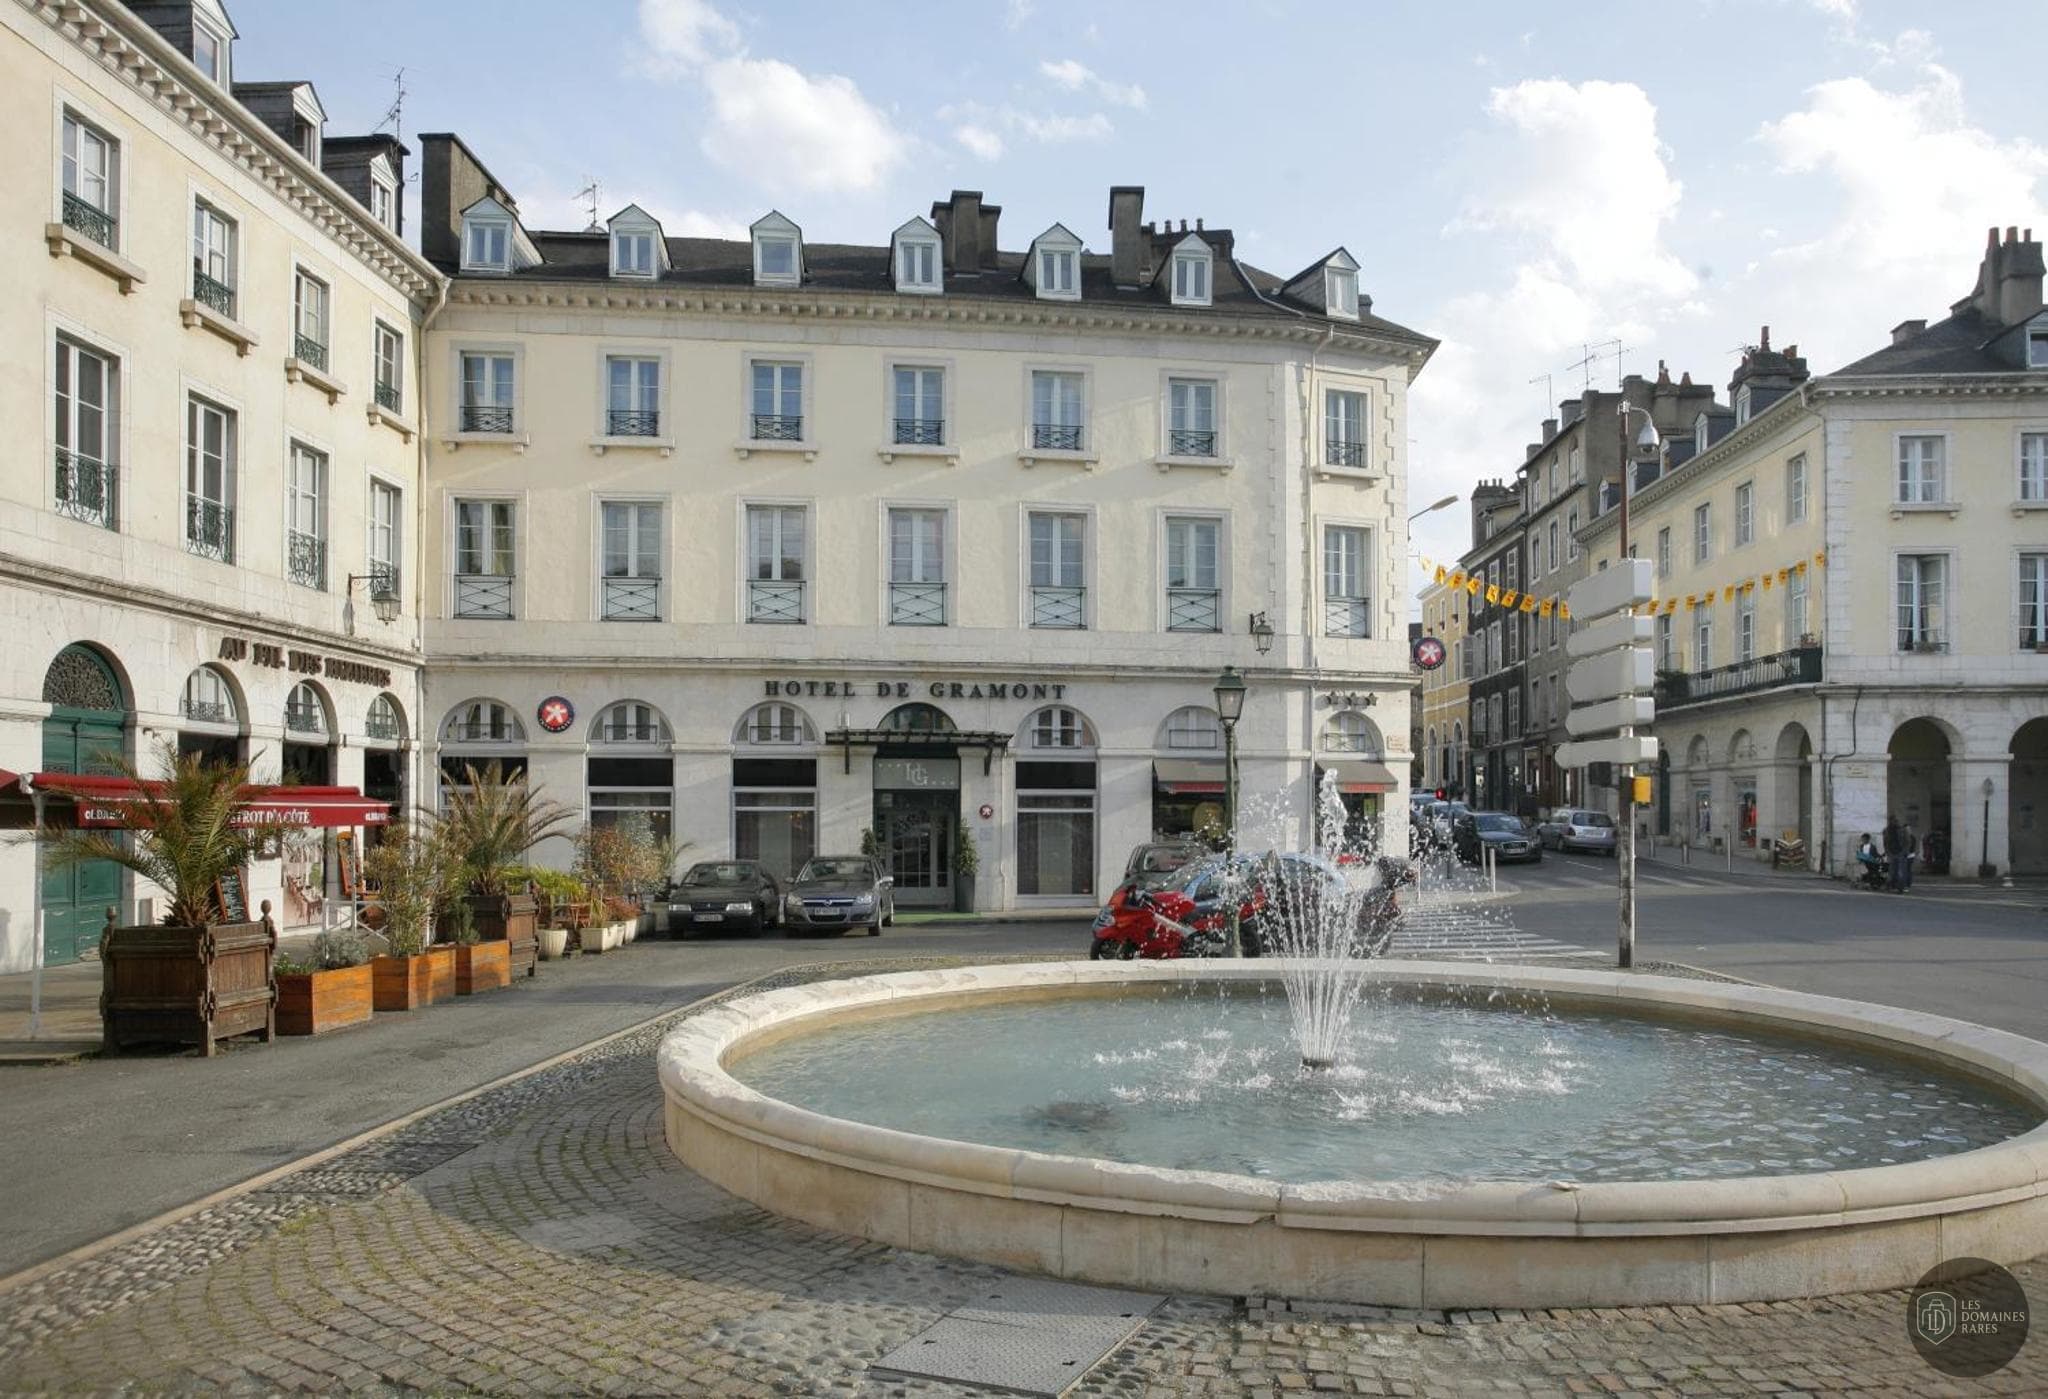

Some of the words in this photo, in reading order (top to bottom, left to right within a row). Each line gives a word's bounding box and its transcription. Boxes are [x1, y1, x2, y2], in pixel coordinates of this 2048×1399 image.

[218, 636, 248, 662] AU
[764, 680, 856, 697] HOTEL
[877, 682, 910, 698] DE
[929, 682, 1067, 699] GRAMONT
